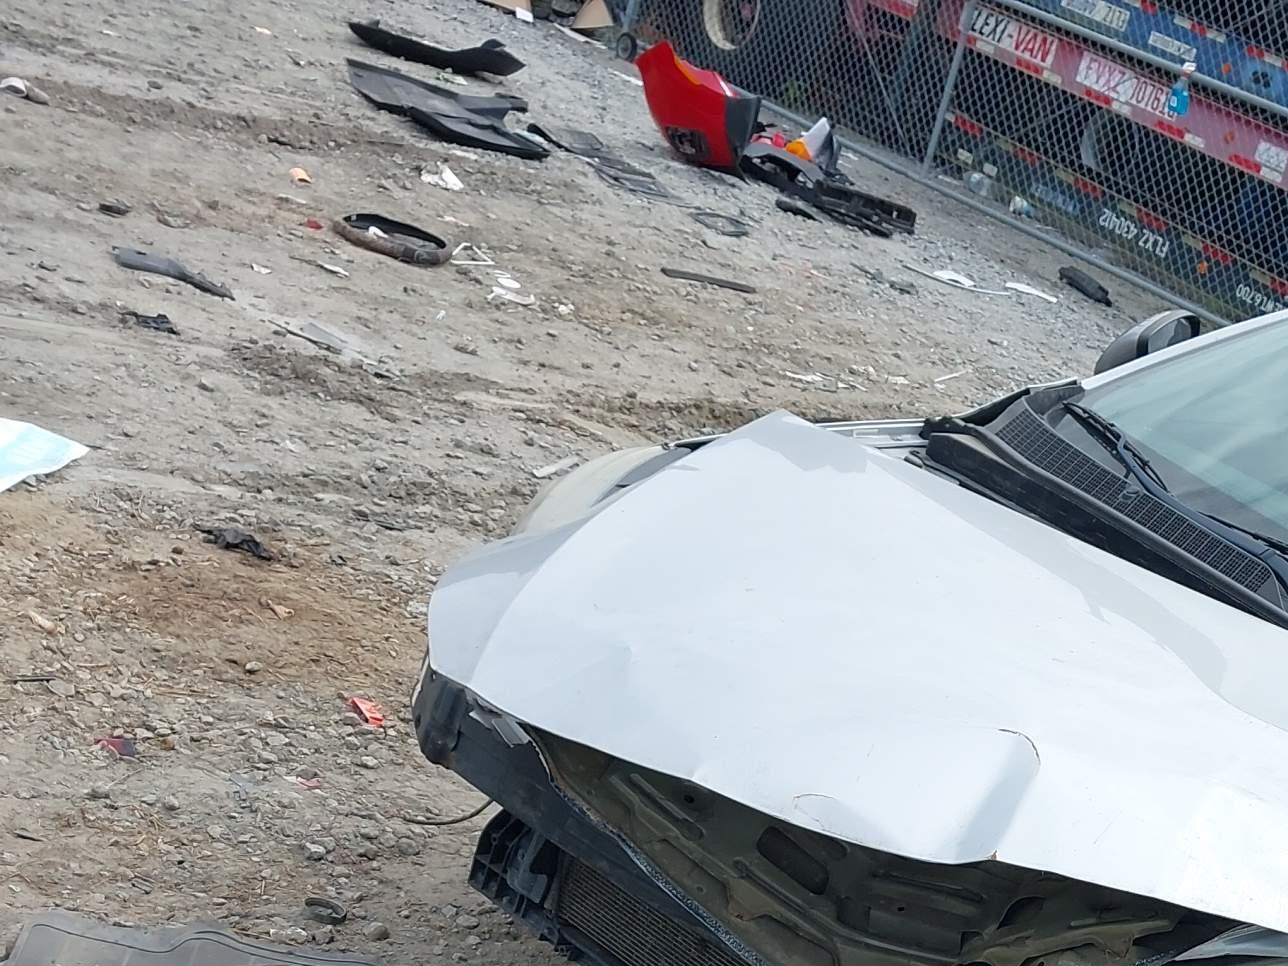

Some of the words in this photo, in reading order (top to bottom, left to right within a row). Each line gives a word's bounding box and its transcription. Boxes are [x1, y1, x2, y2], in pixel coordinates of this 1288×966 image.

[970, 8, 1056, 63] LEXI-VAN
[1099, 208, 1138, 240] 430412
[1138, 228, 1170, 258] FLXZ
